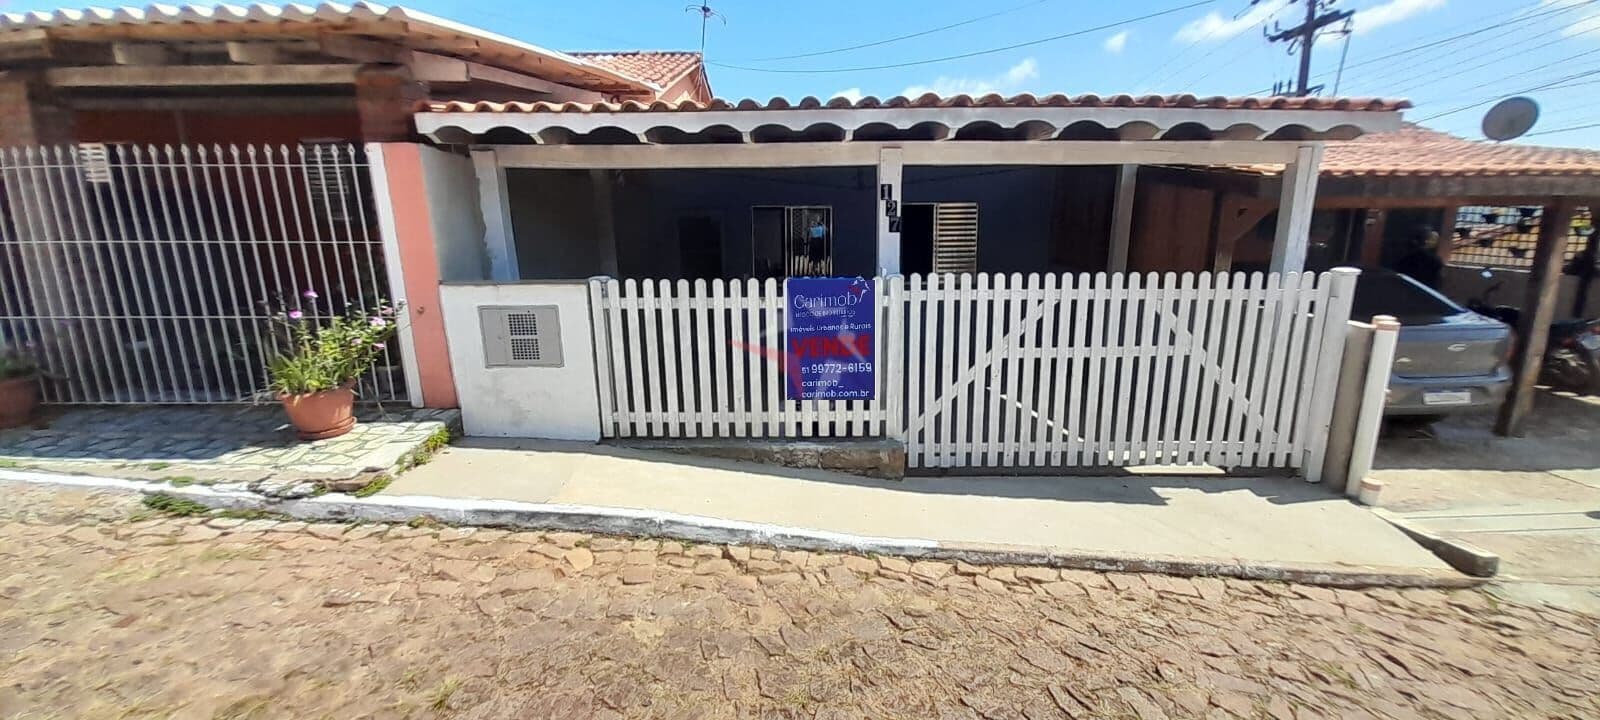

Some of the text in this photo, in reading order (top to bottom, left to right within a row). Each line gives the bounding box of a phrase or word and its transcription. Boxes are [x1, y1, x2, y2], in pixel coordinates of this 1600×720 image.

[882, 184, 900, 232] 127
[794, 292, 857, 309] Carimob
[850, 322, 872, 330] Rurais
[791, 335, 871, 357] VENDE
[801, 362, 872, 374] 51 99772-6159
[801, 390, 870, 398] carimob.com.br
